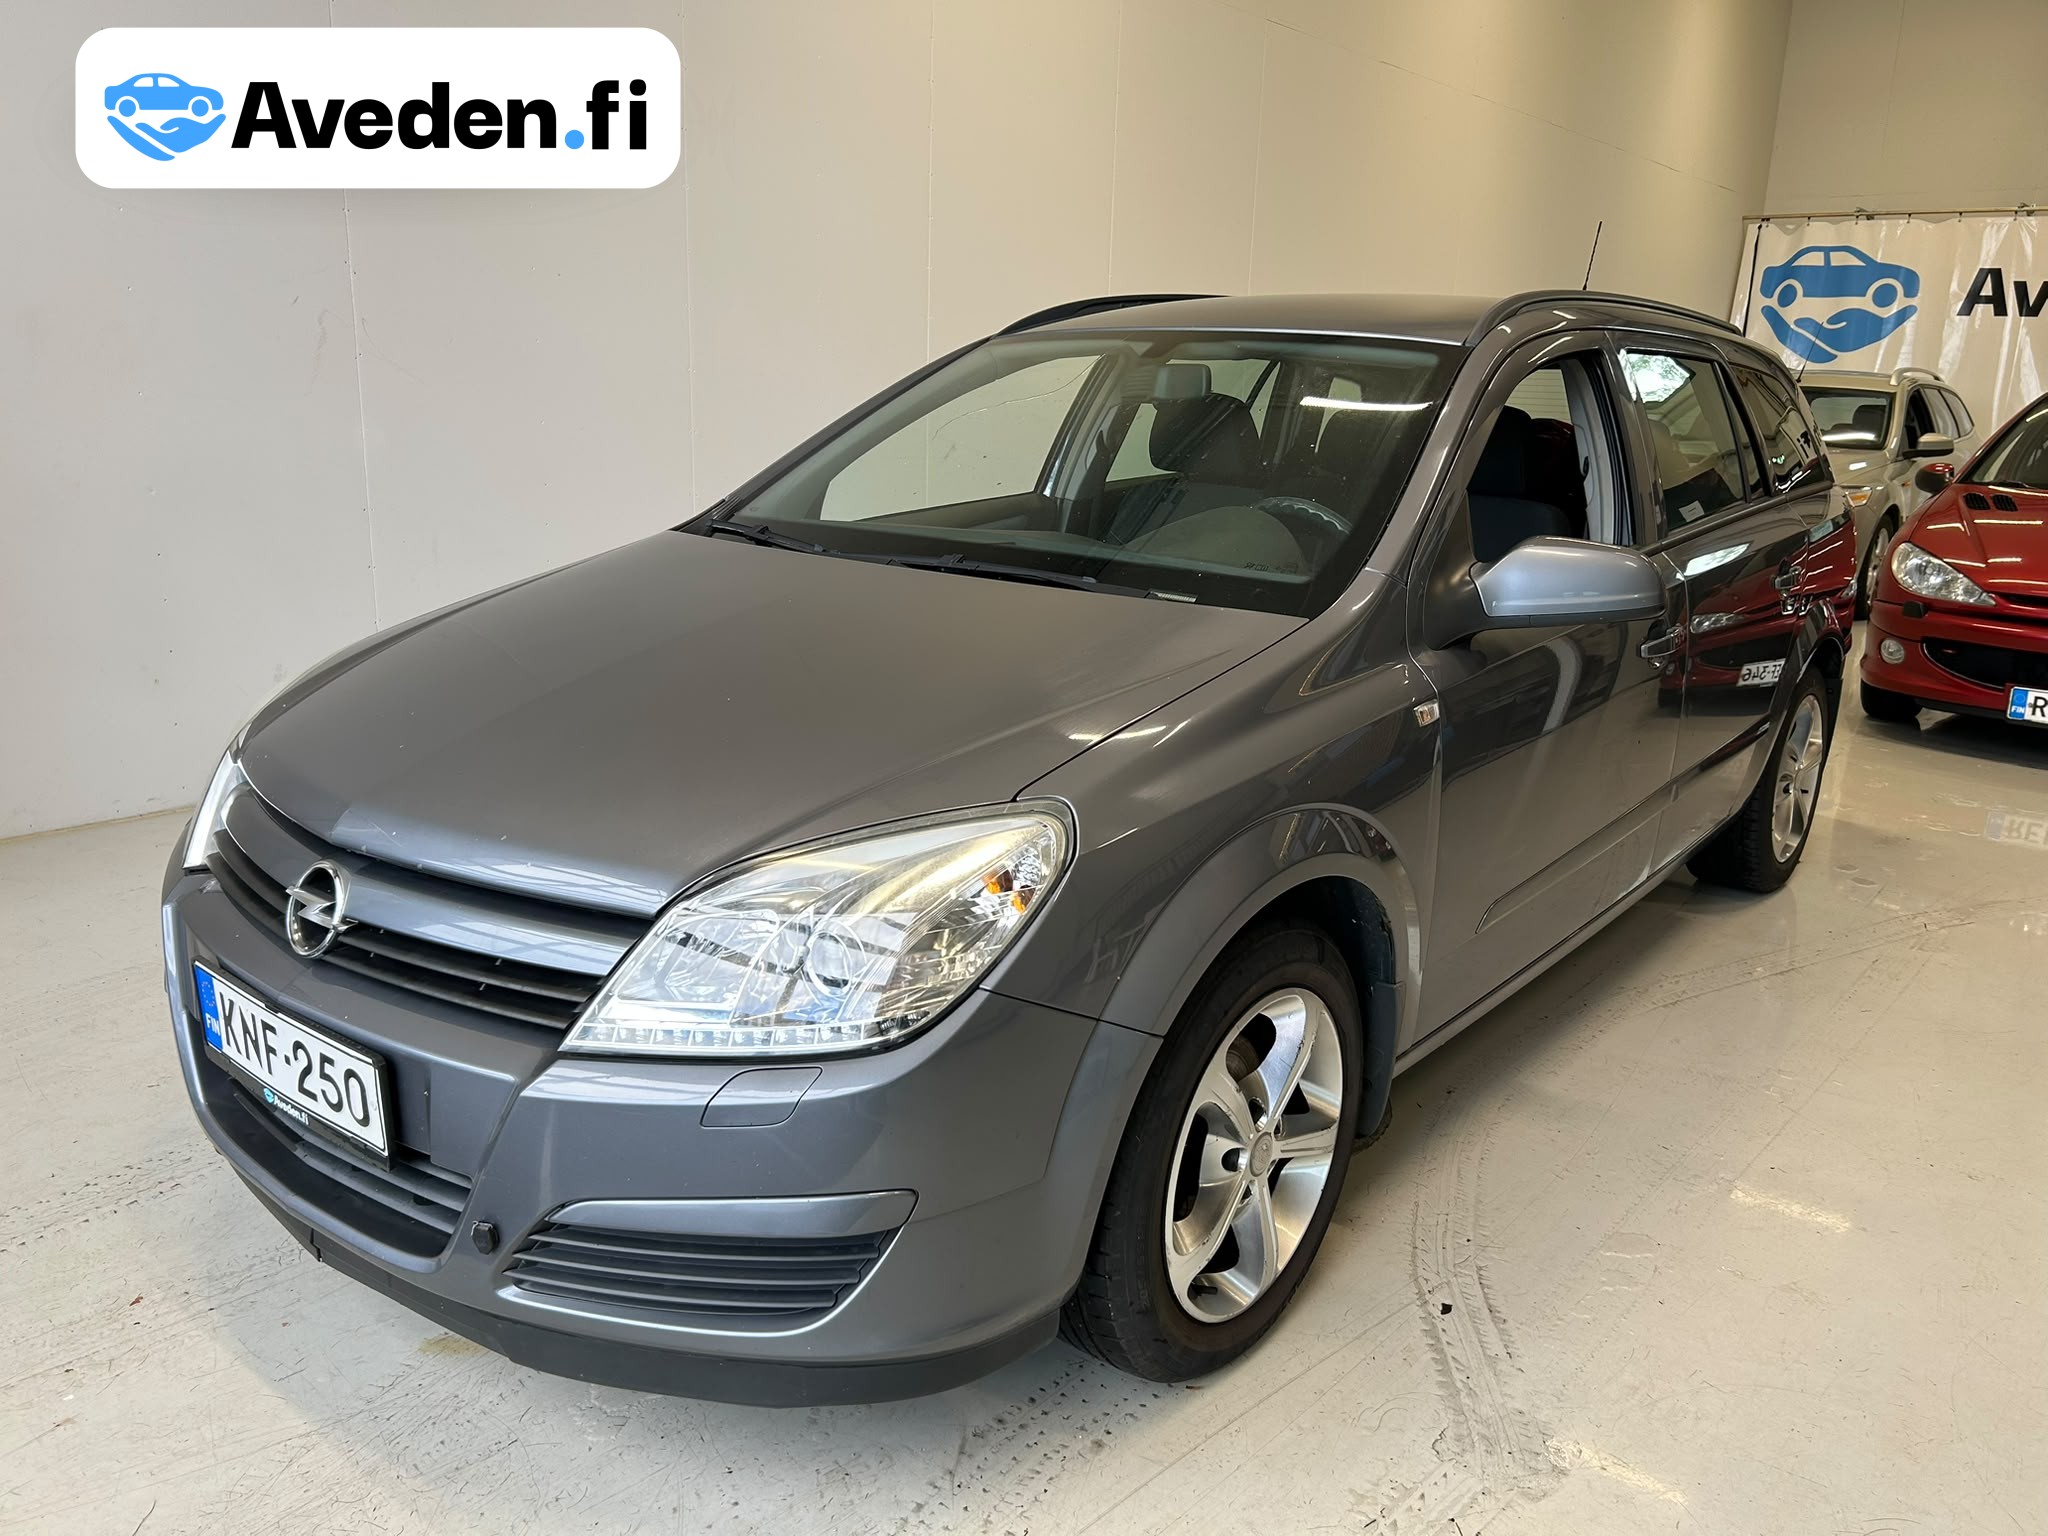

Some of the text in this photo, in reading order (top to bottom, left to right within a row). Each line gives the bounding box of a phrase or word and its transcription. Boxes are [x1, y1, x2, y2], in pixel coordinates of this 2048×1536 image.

[1957, 267, 2048, 318] Av
[2011, 705, 2026, 714] FIN
[205, 1012, 222, 1037] FIN
[219, 991, 371, 1128] KNF-250
